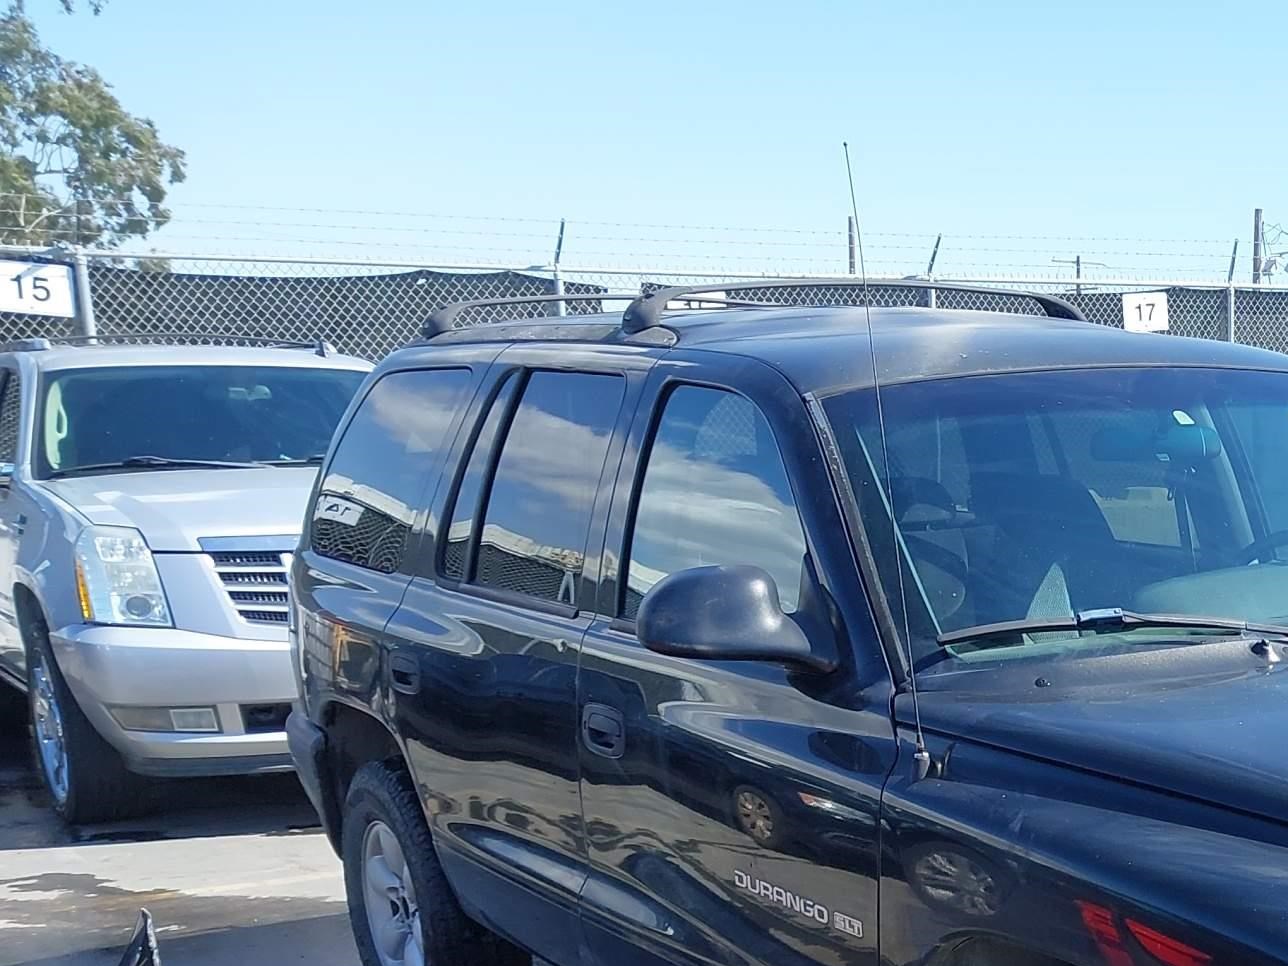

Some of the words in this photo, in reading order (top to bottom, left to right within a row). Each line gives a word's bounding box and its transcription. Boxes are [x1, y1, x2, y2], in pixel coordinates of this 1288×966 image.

[10, 274, 51, 302] 15
[1134, 303, 1156, 321] 17
[733, 869, 829, 924] DURANGO
[834, 911, 864, 938] SLT
